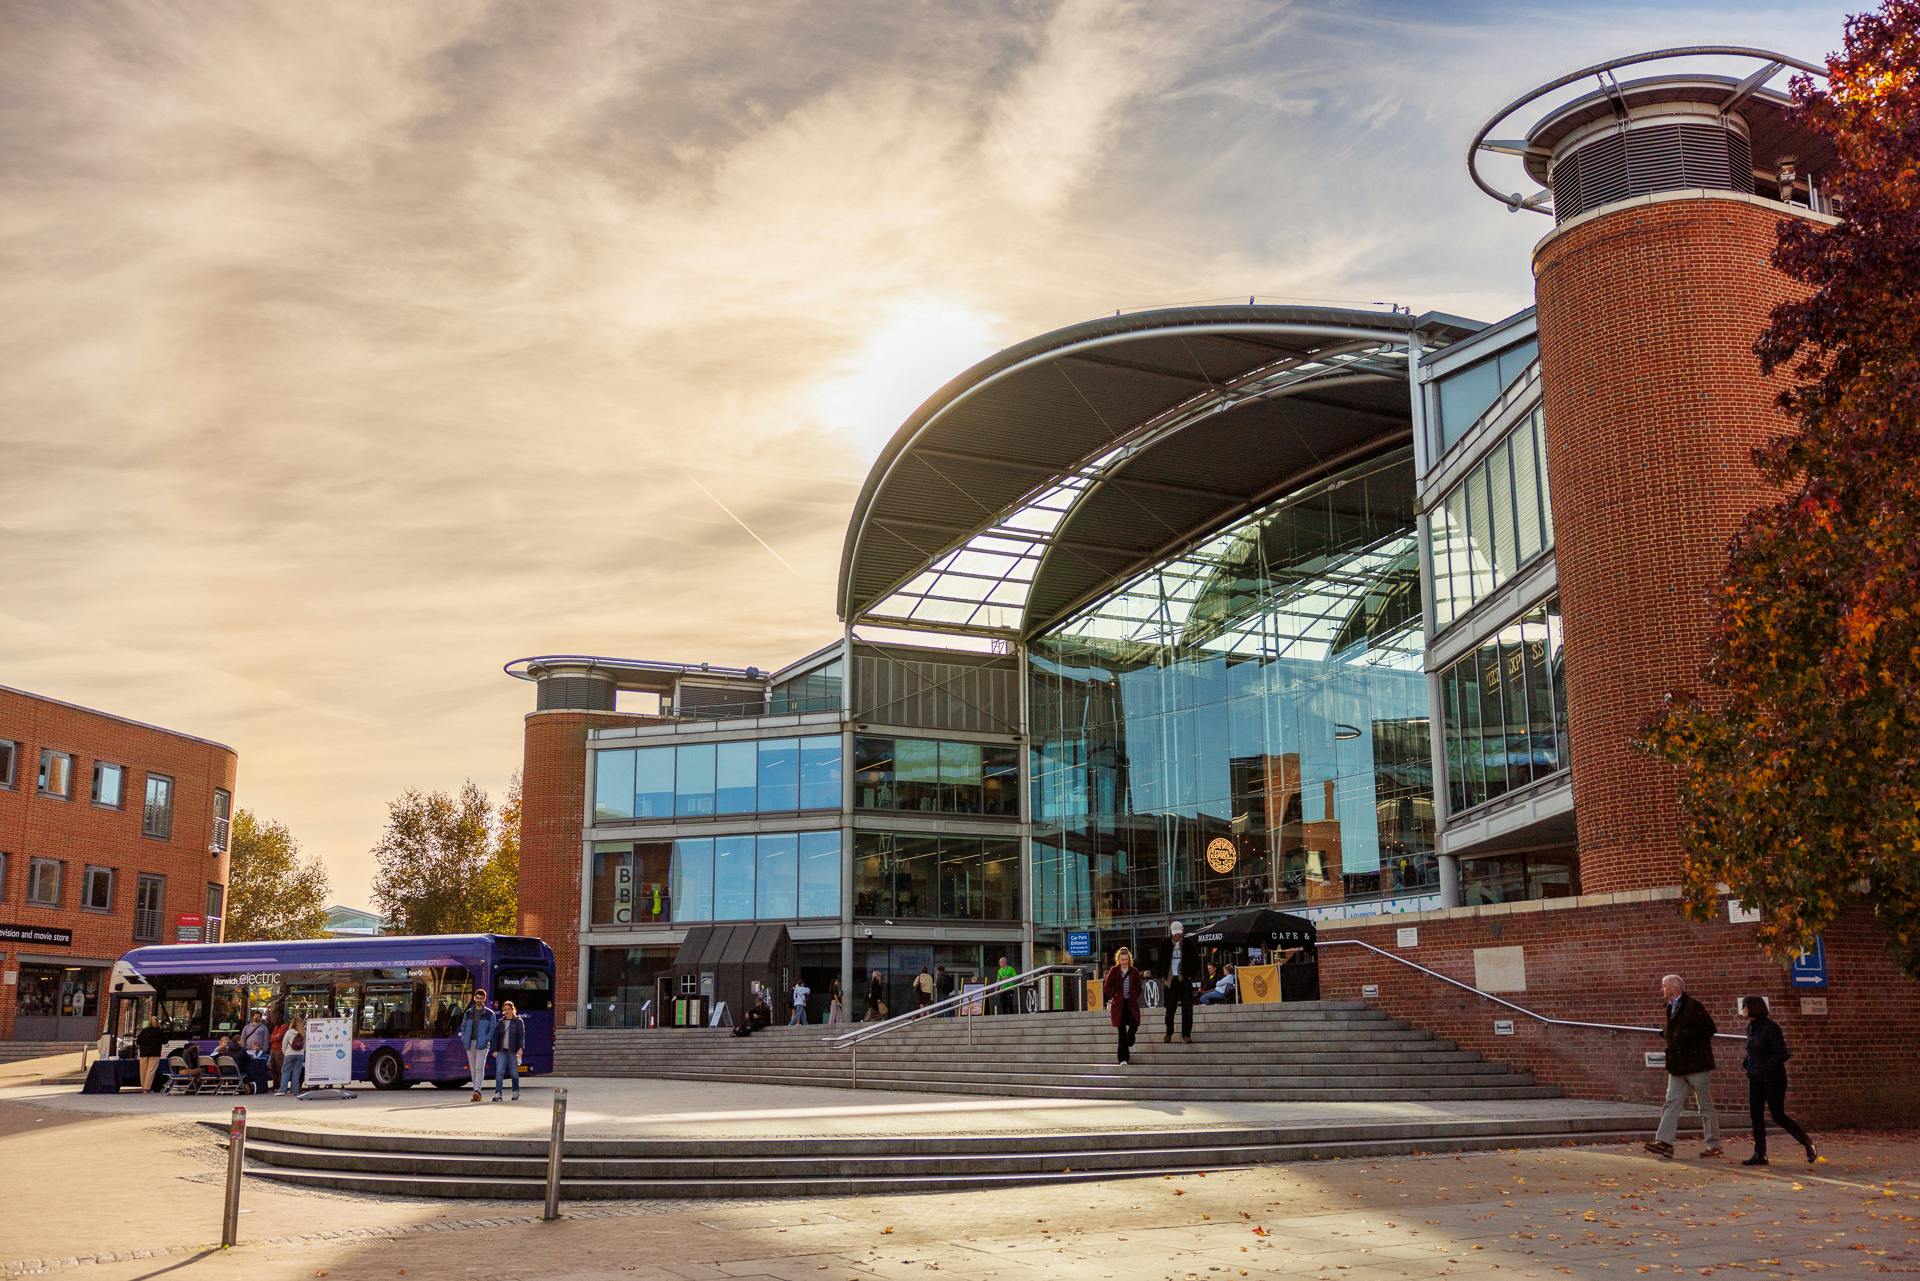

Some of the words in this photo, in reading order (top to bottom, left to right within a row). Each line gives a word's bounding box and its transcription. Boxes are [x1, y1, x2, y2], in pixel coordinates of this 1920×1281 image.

[616, 868, 631, 923] BBC
[21, 930, 33, 939] and
[34, 931, 53, 941] movie
[53, 934, 70, 942] store
[1271, 931, 1299, 941] CAFE
[1304, 931, 1310, 940] &
[313, 961, 335, 969] ELECTRIC
[356, 960, 382, 968] EMISSIONS
[213, 977, 239, 986] Norwich
[239, 971, 281, 986] electric
